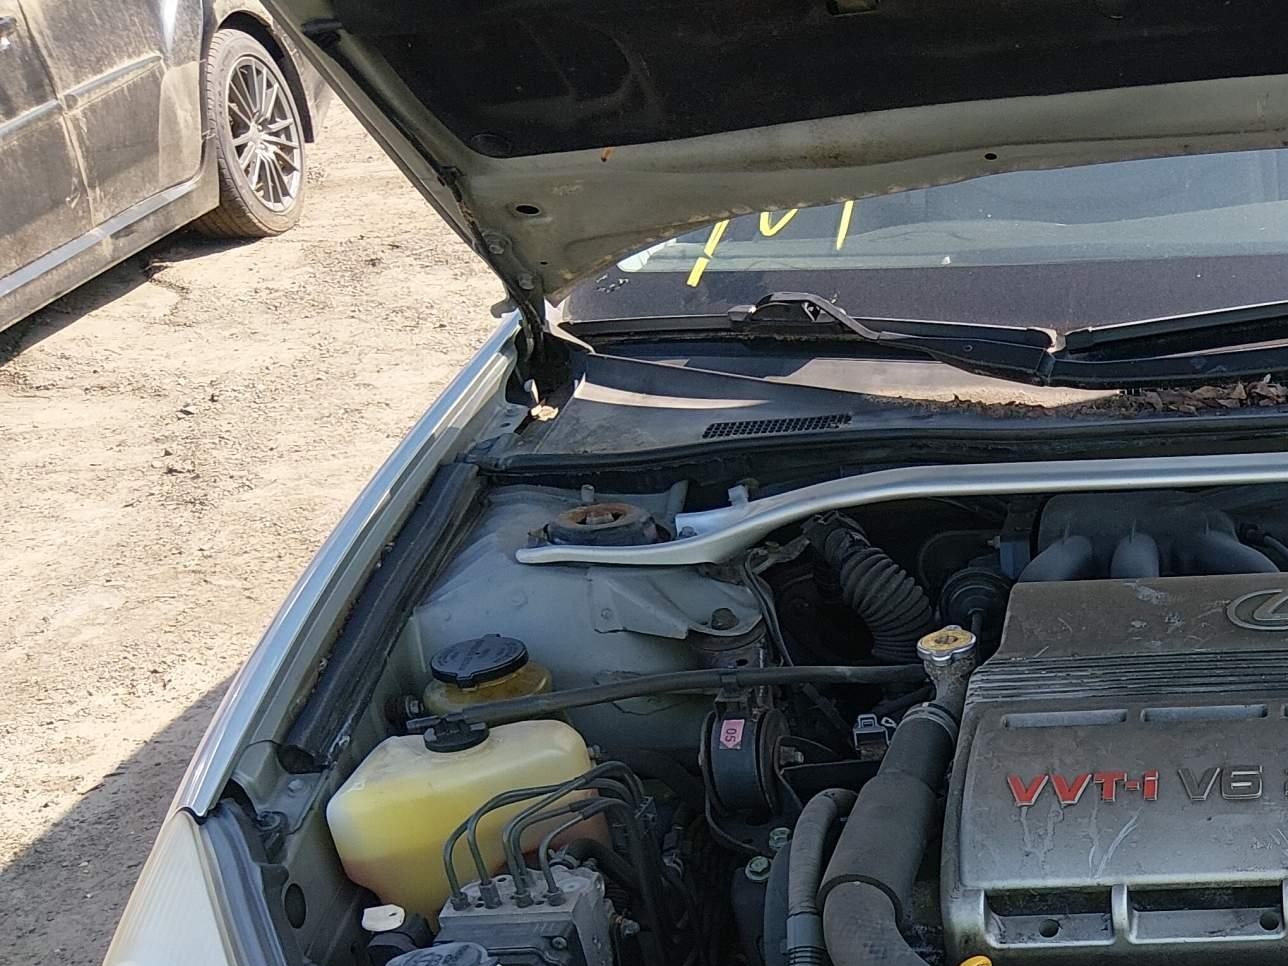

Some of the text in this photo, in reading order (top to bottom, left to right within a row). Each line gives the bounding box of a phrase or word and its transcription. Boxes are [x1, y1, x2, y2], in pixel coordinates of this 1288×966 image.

[725, 728, 737, 742] 05
[1007, 771, 1158, 807] VVT-i
[1178, 766, 1262, 800] V6
